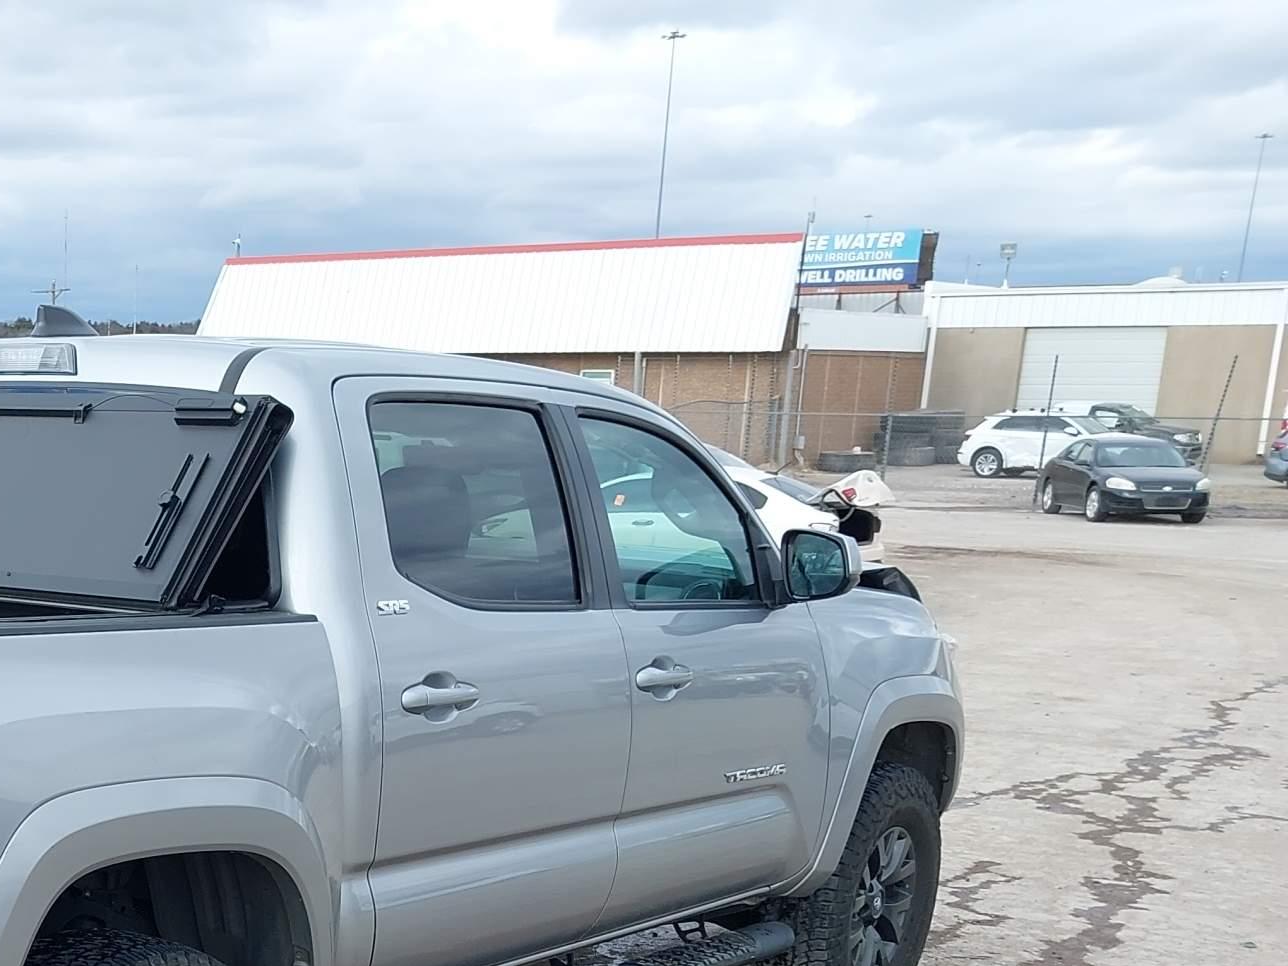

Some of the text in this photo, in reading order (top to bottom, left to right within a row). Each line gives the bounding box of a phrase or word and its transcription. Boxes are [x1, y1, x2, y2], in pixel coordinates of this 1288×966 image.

[834, 230, 906, 250] WATER
[824, 249, 894, 262] IRRIGATION
[833, 267, 906, 283] DRILLING
[376, 599, 410, 616] SR5
[725, 763, 787, 783] TACOMA
